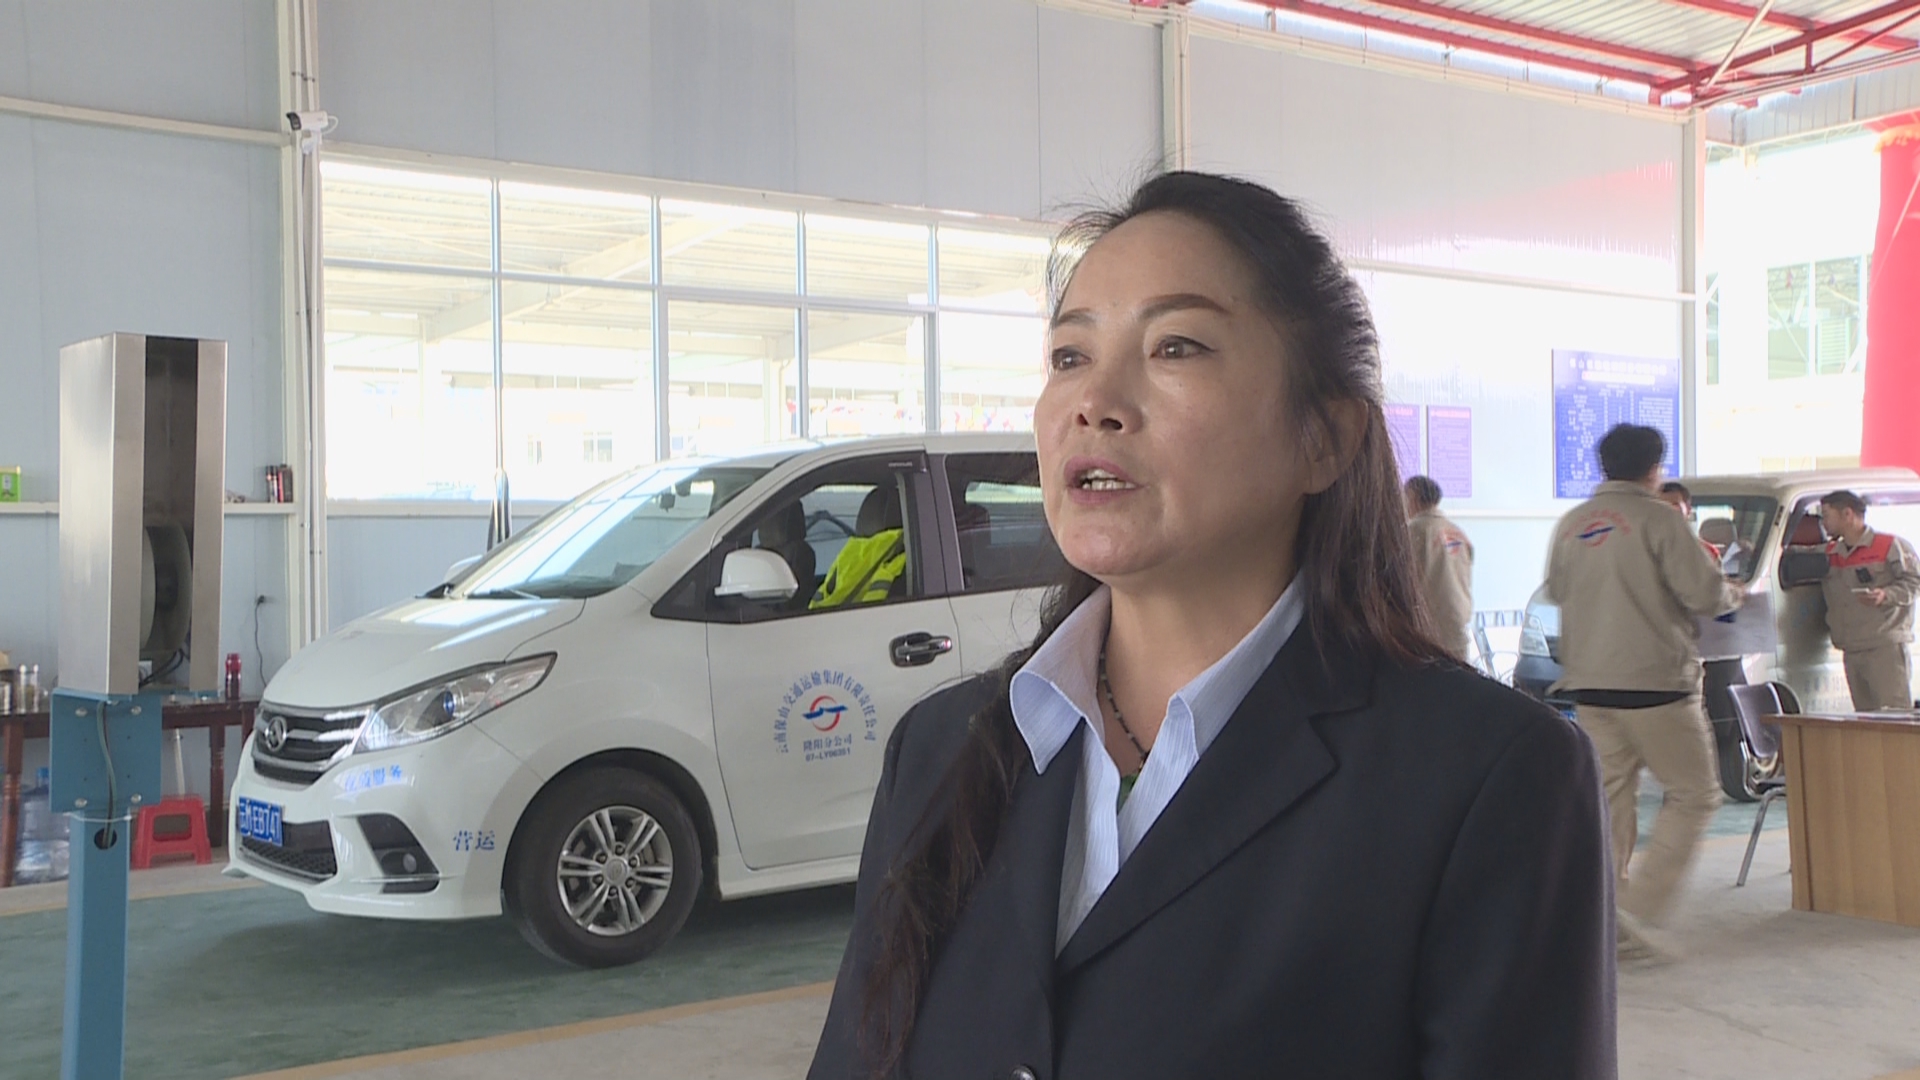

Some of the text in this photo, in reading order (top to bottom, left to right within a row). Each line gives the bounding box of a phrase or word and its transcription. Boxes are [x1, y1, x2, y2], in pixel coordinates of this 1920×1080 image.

[803, 733, 852, 752] 隆阳分公司
[453, 830, 496, 852] 营运
